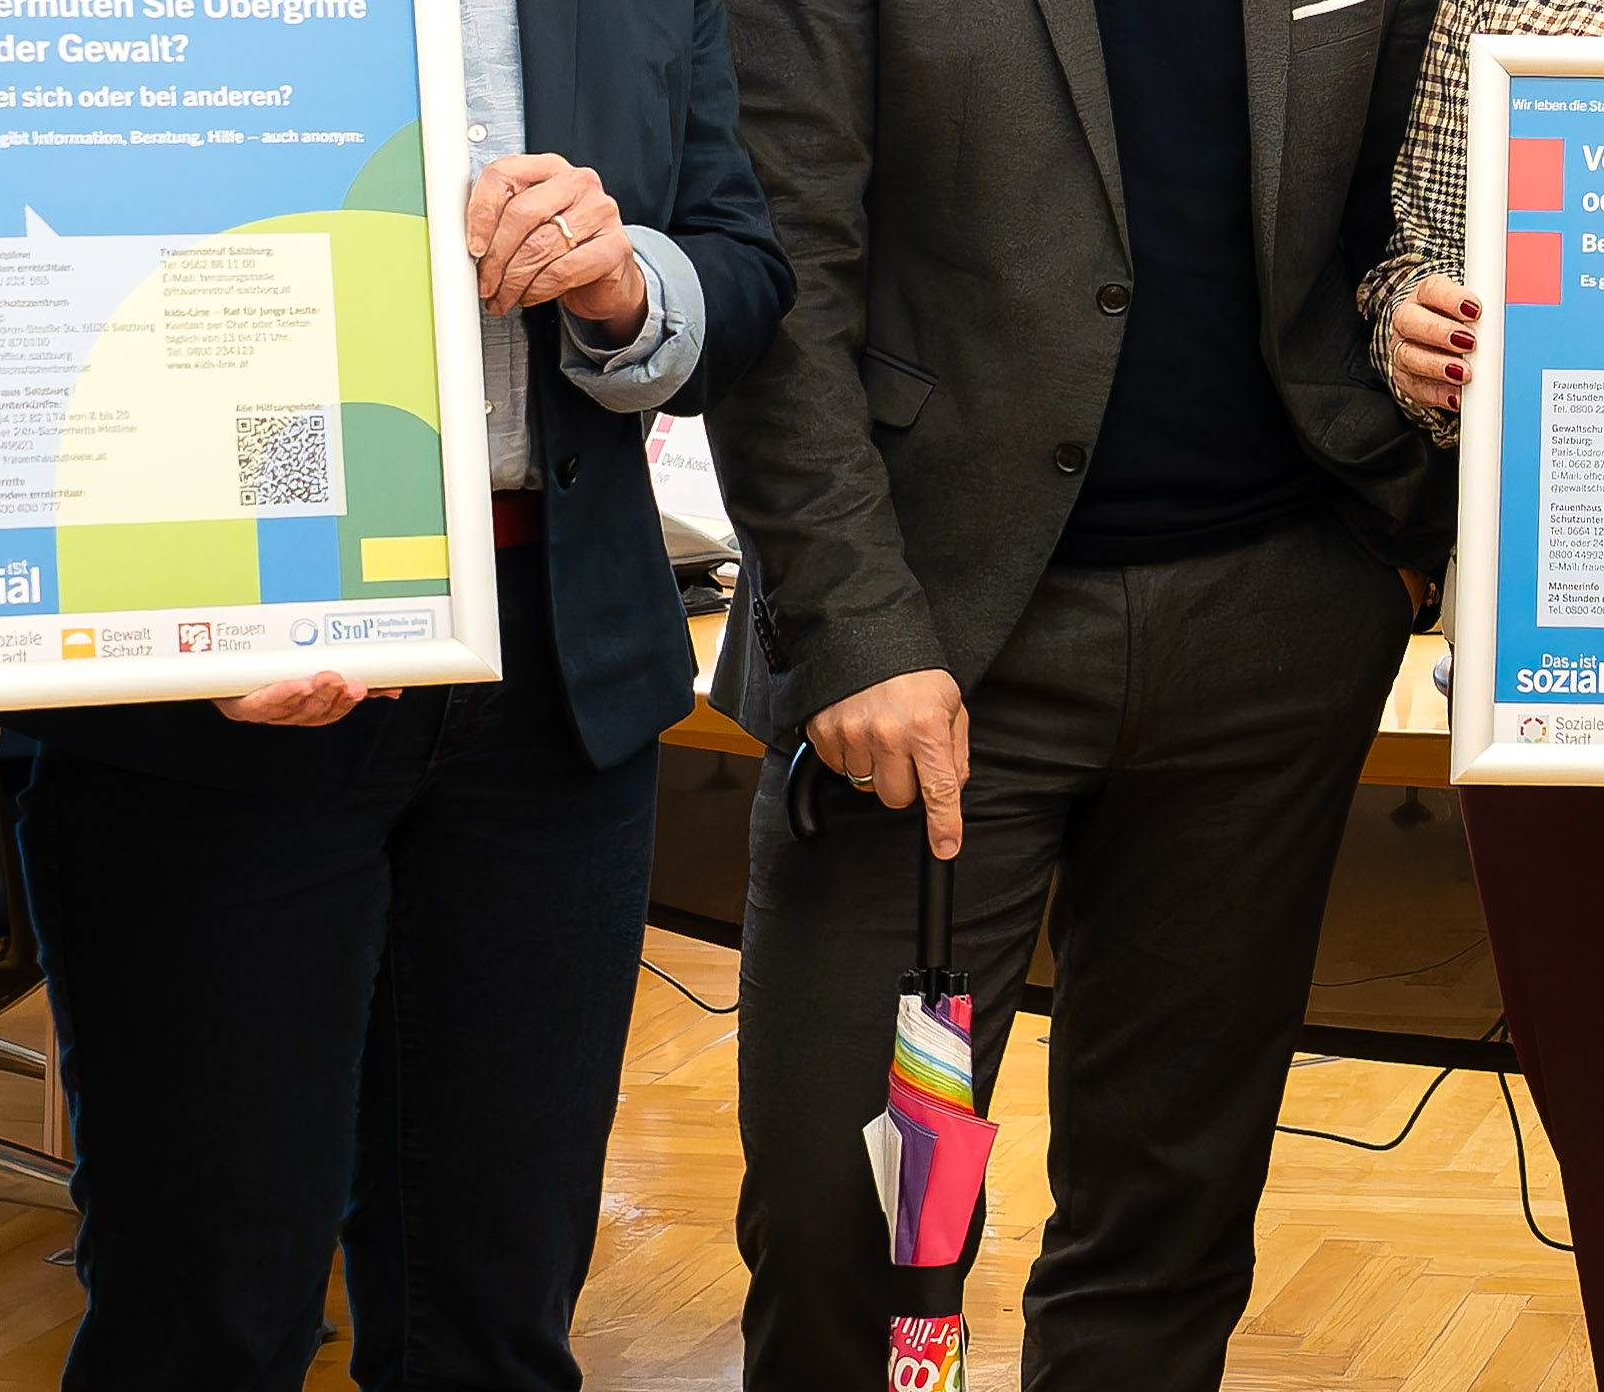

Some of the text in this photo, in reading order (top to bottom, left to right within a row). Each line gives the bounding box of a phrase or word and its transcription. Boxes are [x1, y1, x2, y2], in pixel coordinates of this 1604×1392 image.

[59, 34, 188, 62] Gewalt?
[23, 86, 72, 107] sich
[79, 86, 134, 107] oder
[140, 86, 177, 107] bei
[183, 85, 292, 106] anderen?
[1512, 98, 1533, 111] Wir
[1535, 98, 1566, 112] leben
[1569, 99, 1587, 113] die
[1580, 275, 1597, 289] Es
[1542, 654, 1598, 669] Das ist
[1555, 717, 1604, 731] Soziale
[1555, 732, 1591, 745] Stadt
